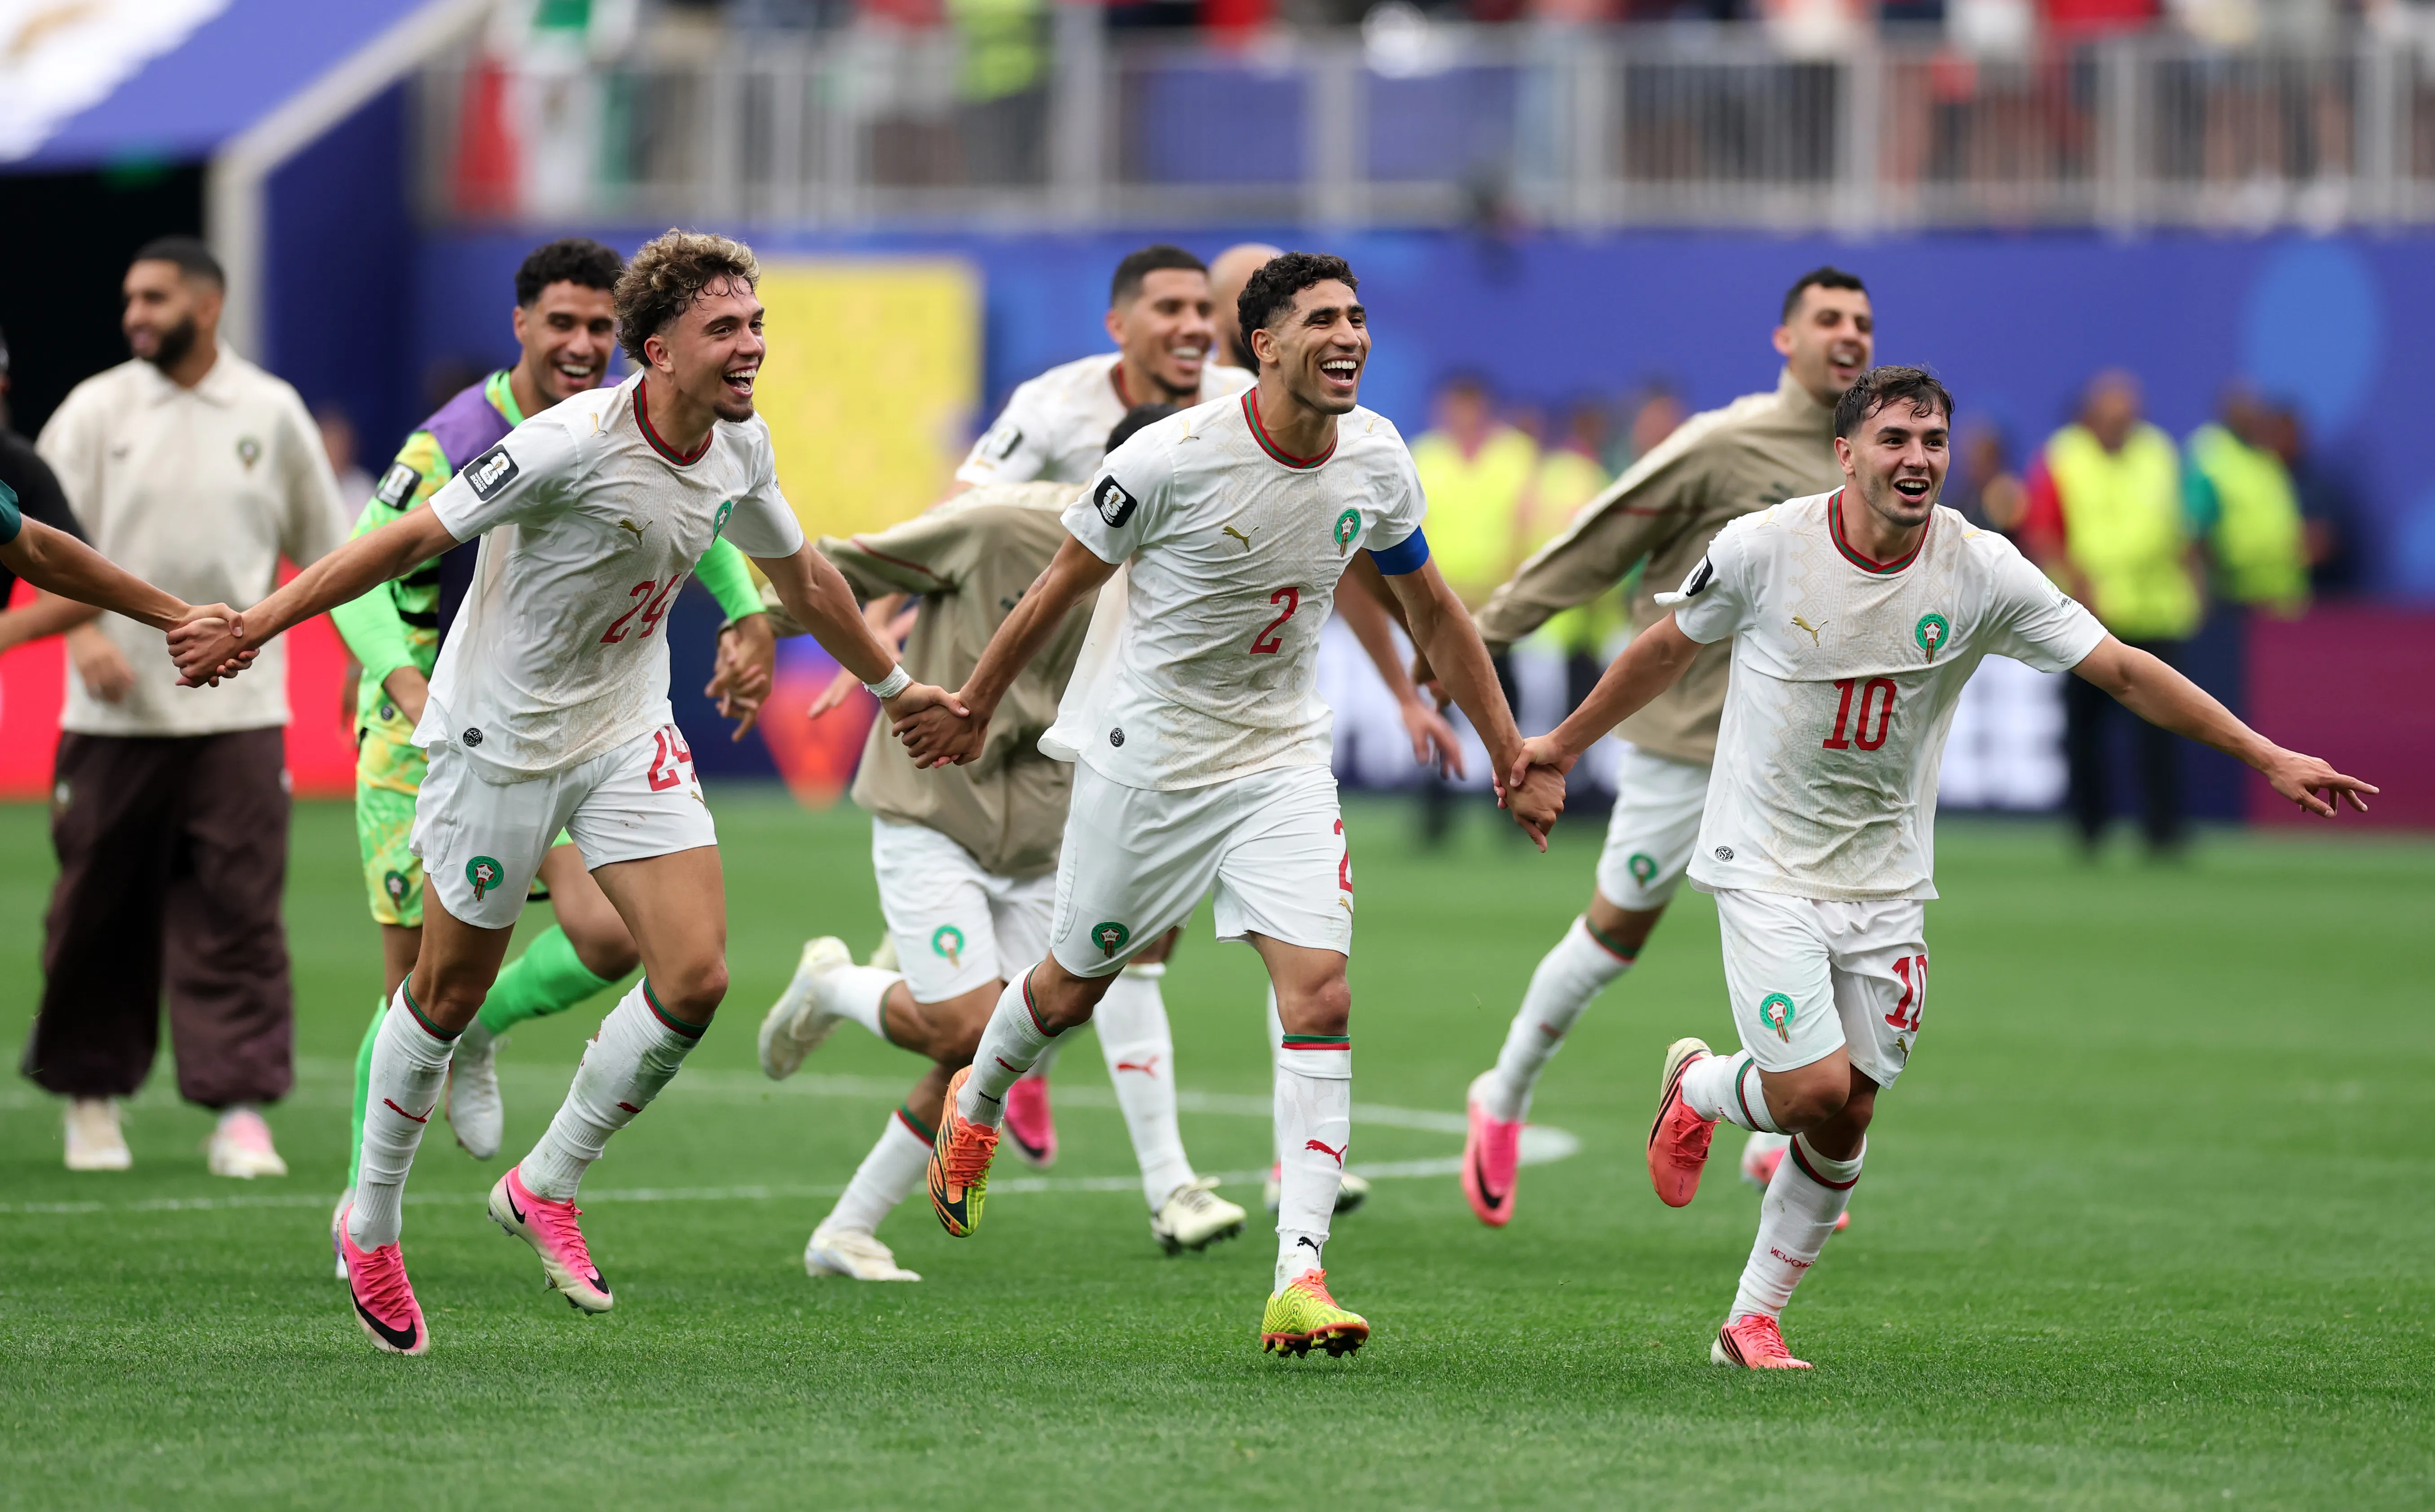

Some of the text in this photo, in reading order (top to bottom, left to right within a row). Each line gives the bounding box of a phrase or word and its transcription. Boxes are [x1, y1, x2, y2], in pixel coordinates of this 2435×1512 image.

[470, 475, 484, 493] 2026
[1100, 506, 1113, 523] 2026
[600, 573, 681, 643] 24
[1251, 587, 1299, 654] 2
[1823, 678, 1897, 751] 10
[647, 726, 696, 791] 24
[1885, 954, 1928, 1032] 10
